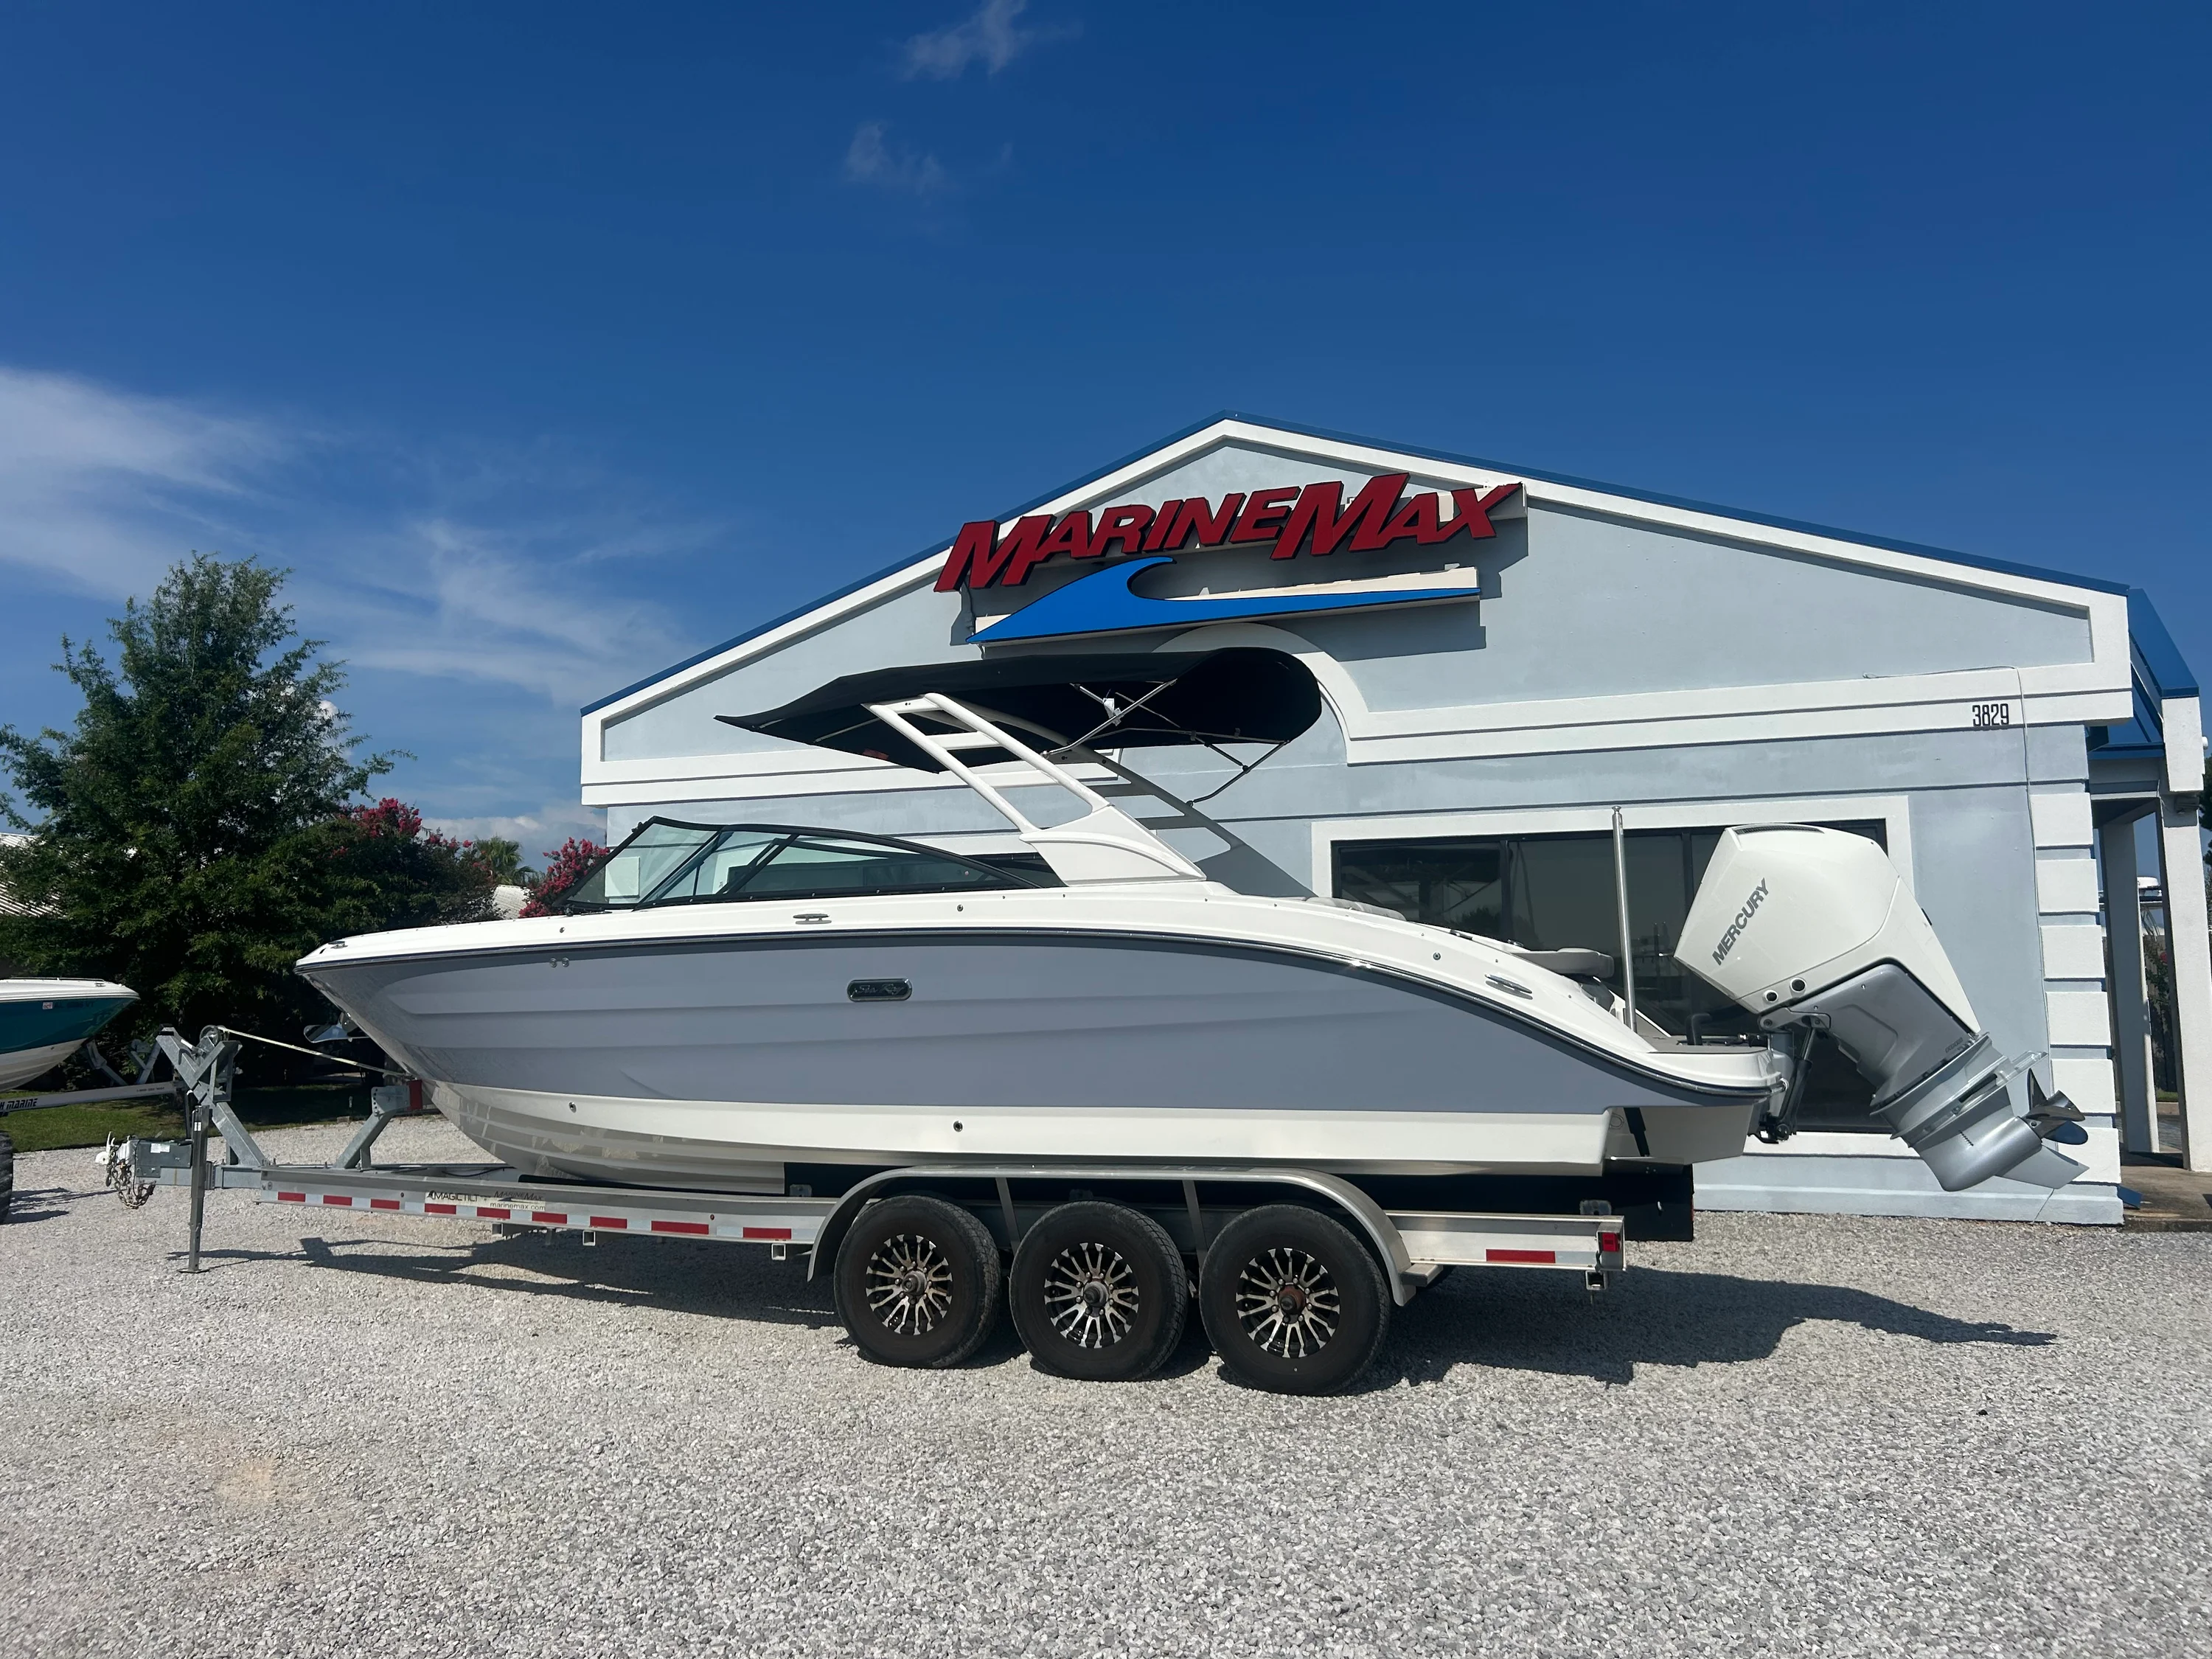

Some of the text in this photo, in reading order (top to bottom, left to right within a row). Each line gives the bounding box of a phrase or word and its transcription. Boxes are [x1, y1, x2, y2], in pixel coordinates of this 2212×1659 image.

[1972, 703, 2009, 726] 3829
[1711, 877, 1769, 966] MERCURY
[490, 1202, 546, 1211] marinemax.com
